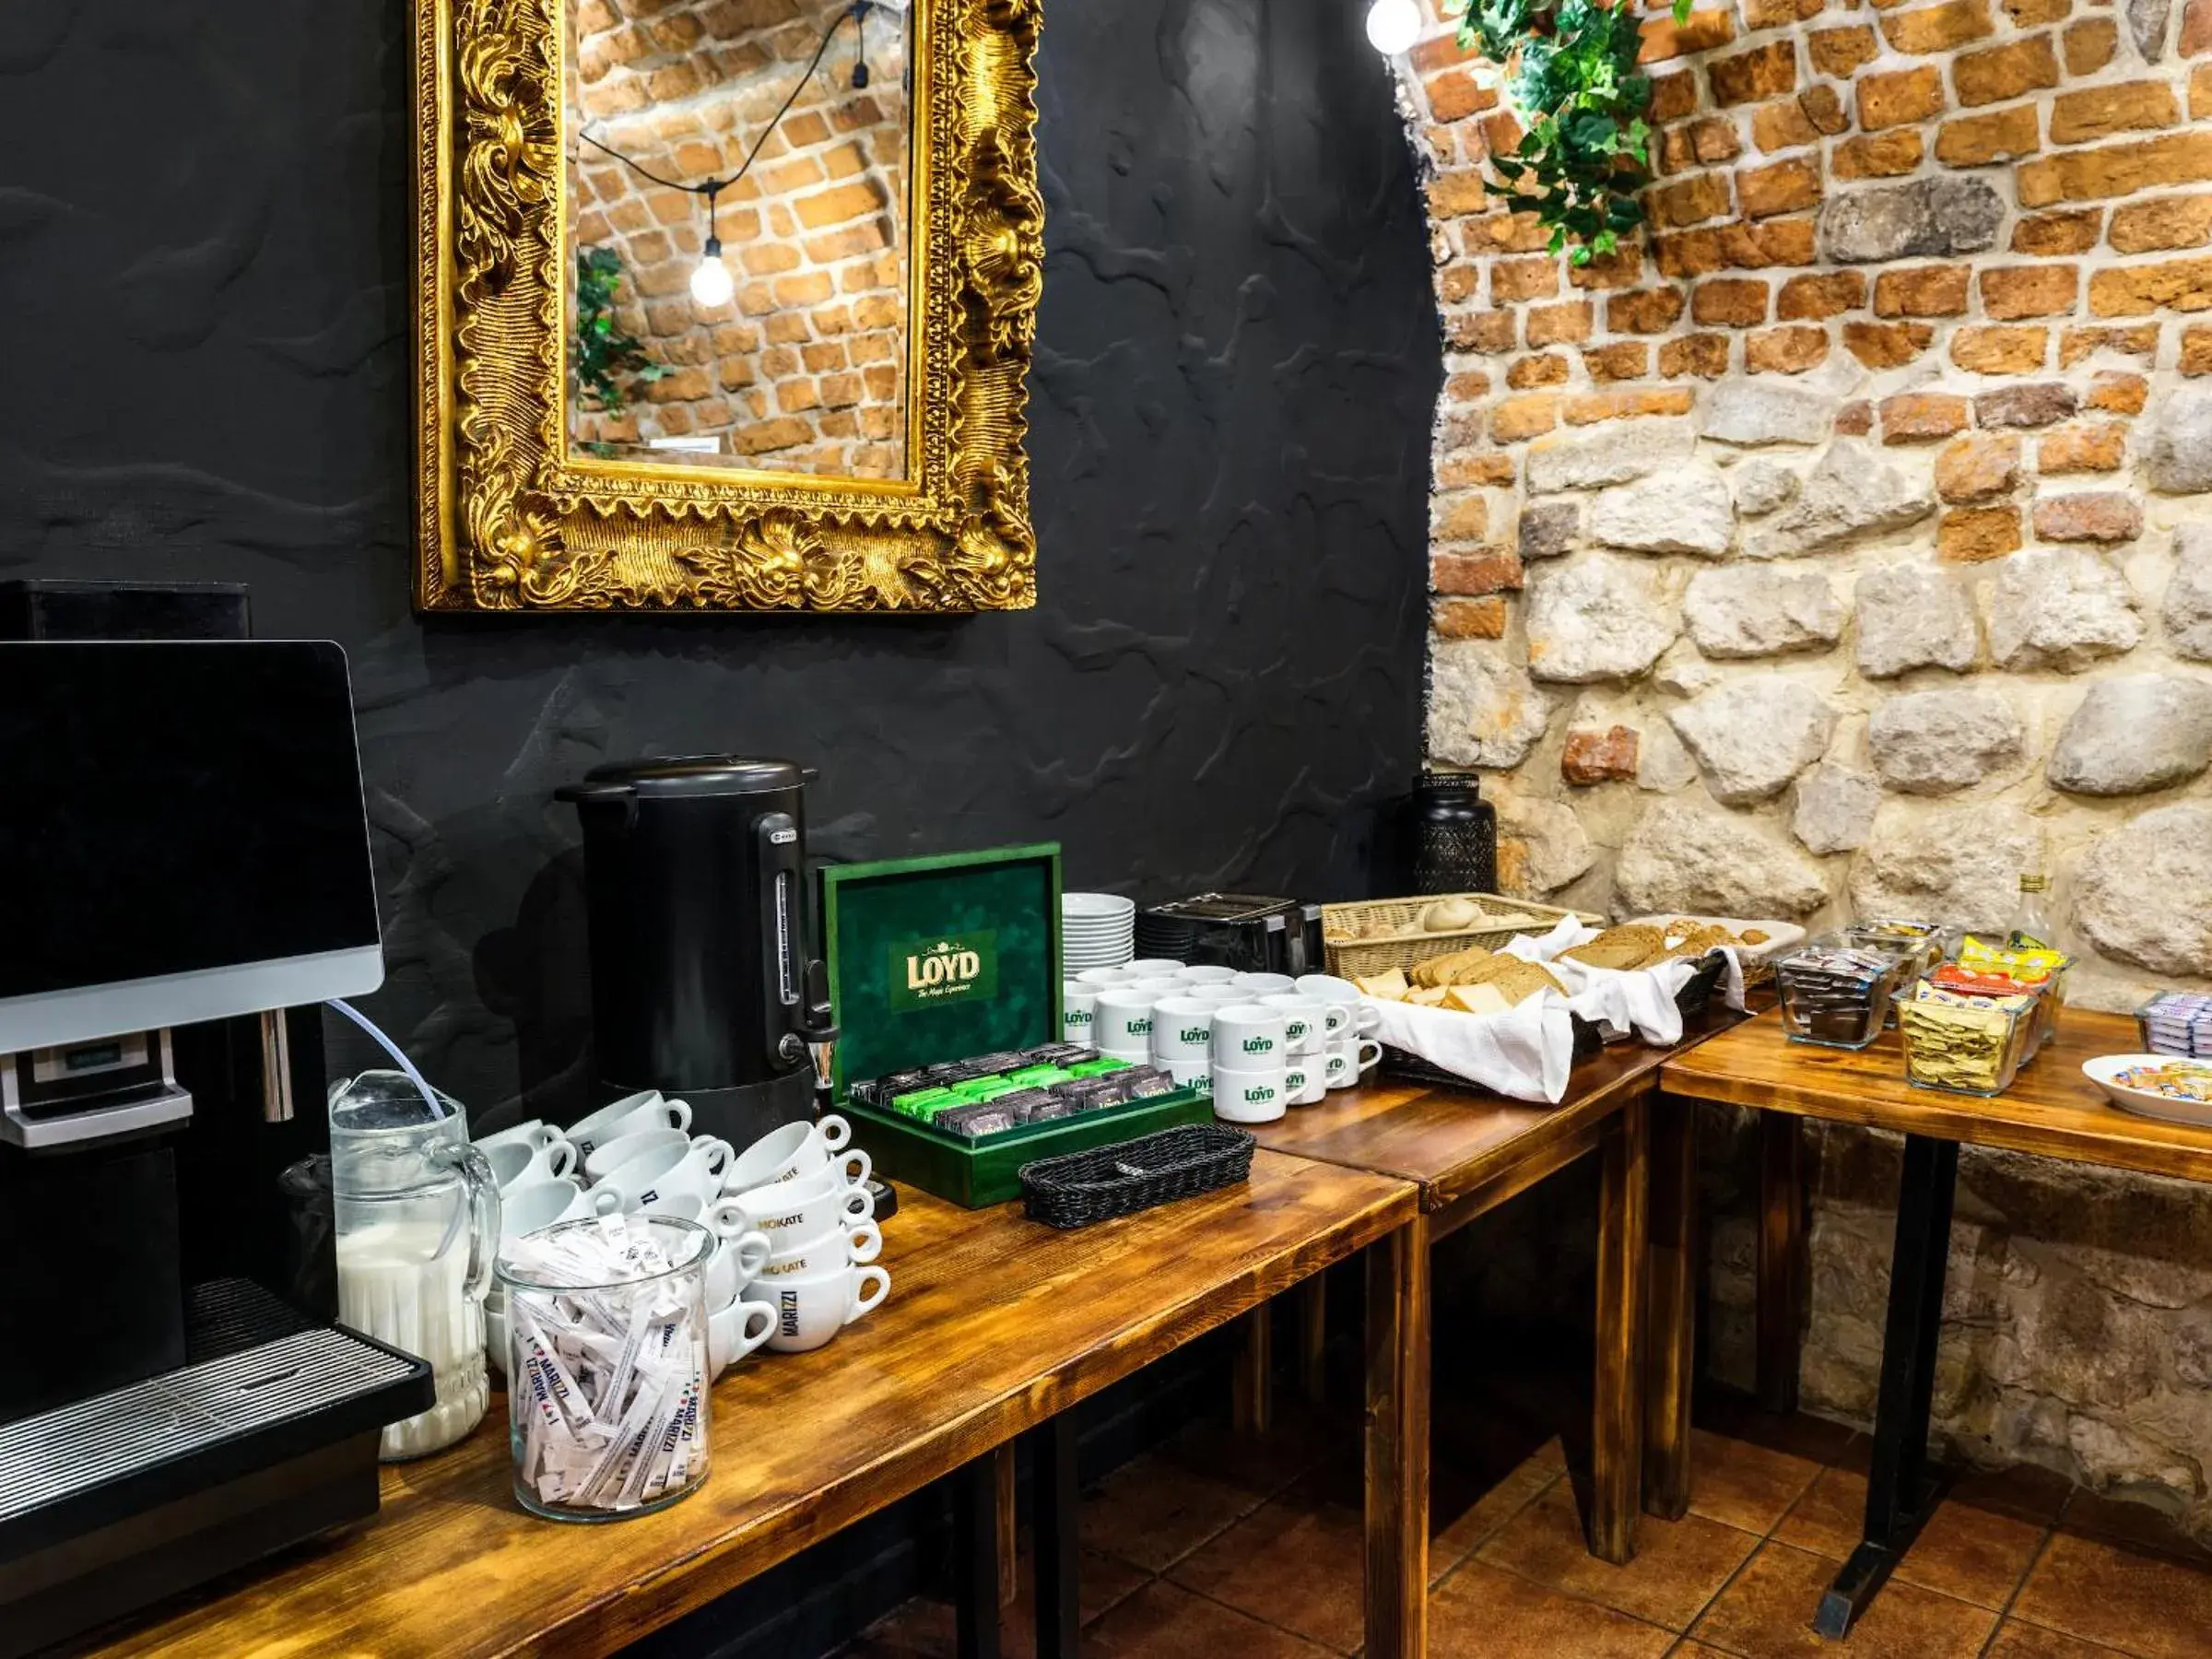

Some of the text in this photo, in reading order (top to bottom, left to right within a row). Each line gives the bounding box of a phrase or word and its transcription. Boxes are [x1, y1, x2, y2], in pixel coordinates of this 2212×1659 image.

[907, 951, 980, 989] LOYD
[1065, 1012, 1092, 1024] LOYD
[1181, 1030, 1209, 1042] LOYD
[1243, 1039, 1273, 1053] LOYD
[1245, 1088, 1275, 1102] LOYD
[782, 1291, 799, 1336] MARIZZI
[526, 1357, 549, 1402] MARIZZI
[539, 1358, 571, 1399] MARIZZI
